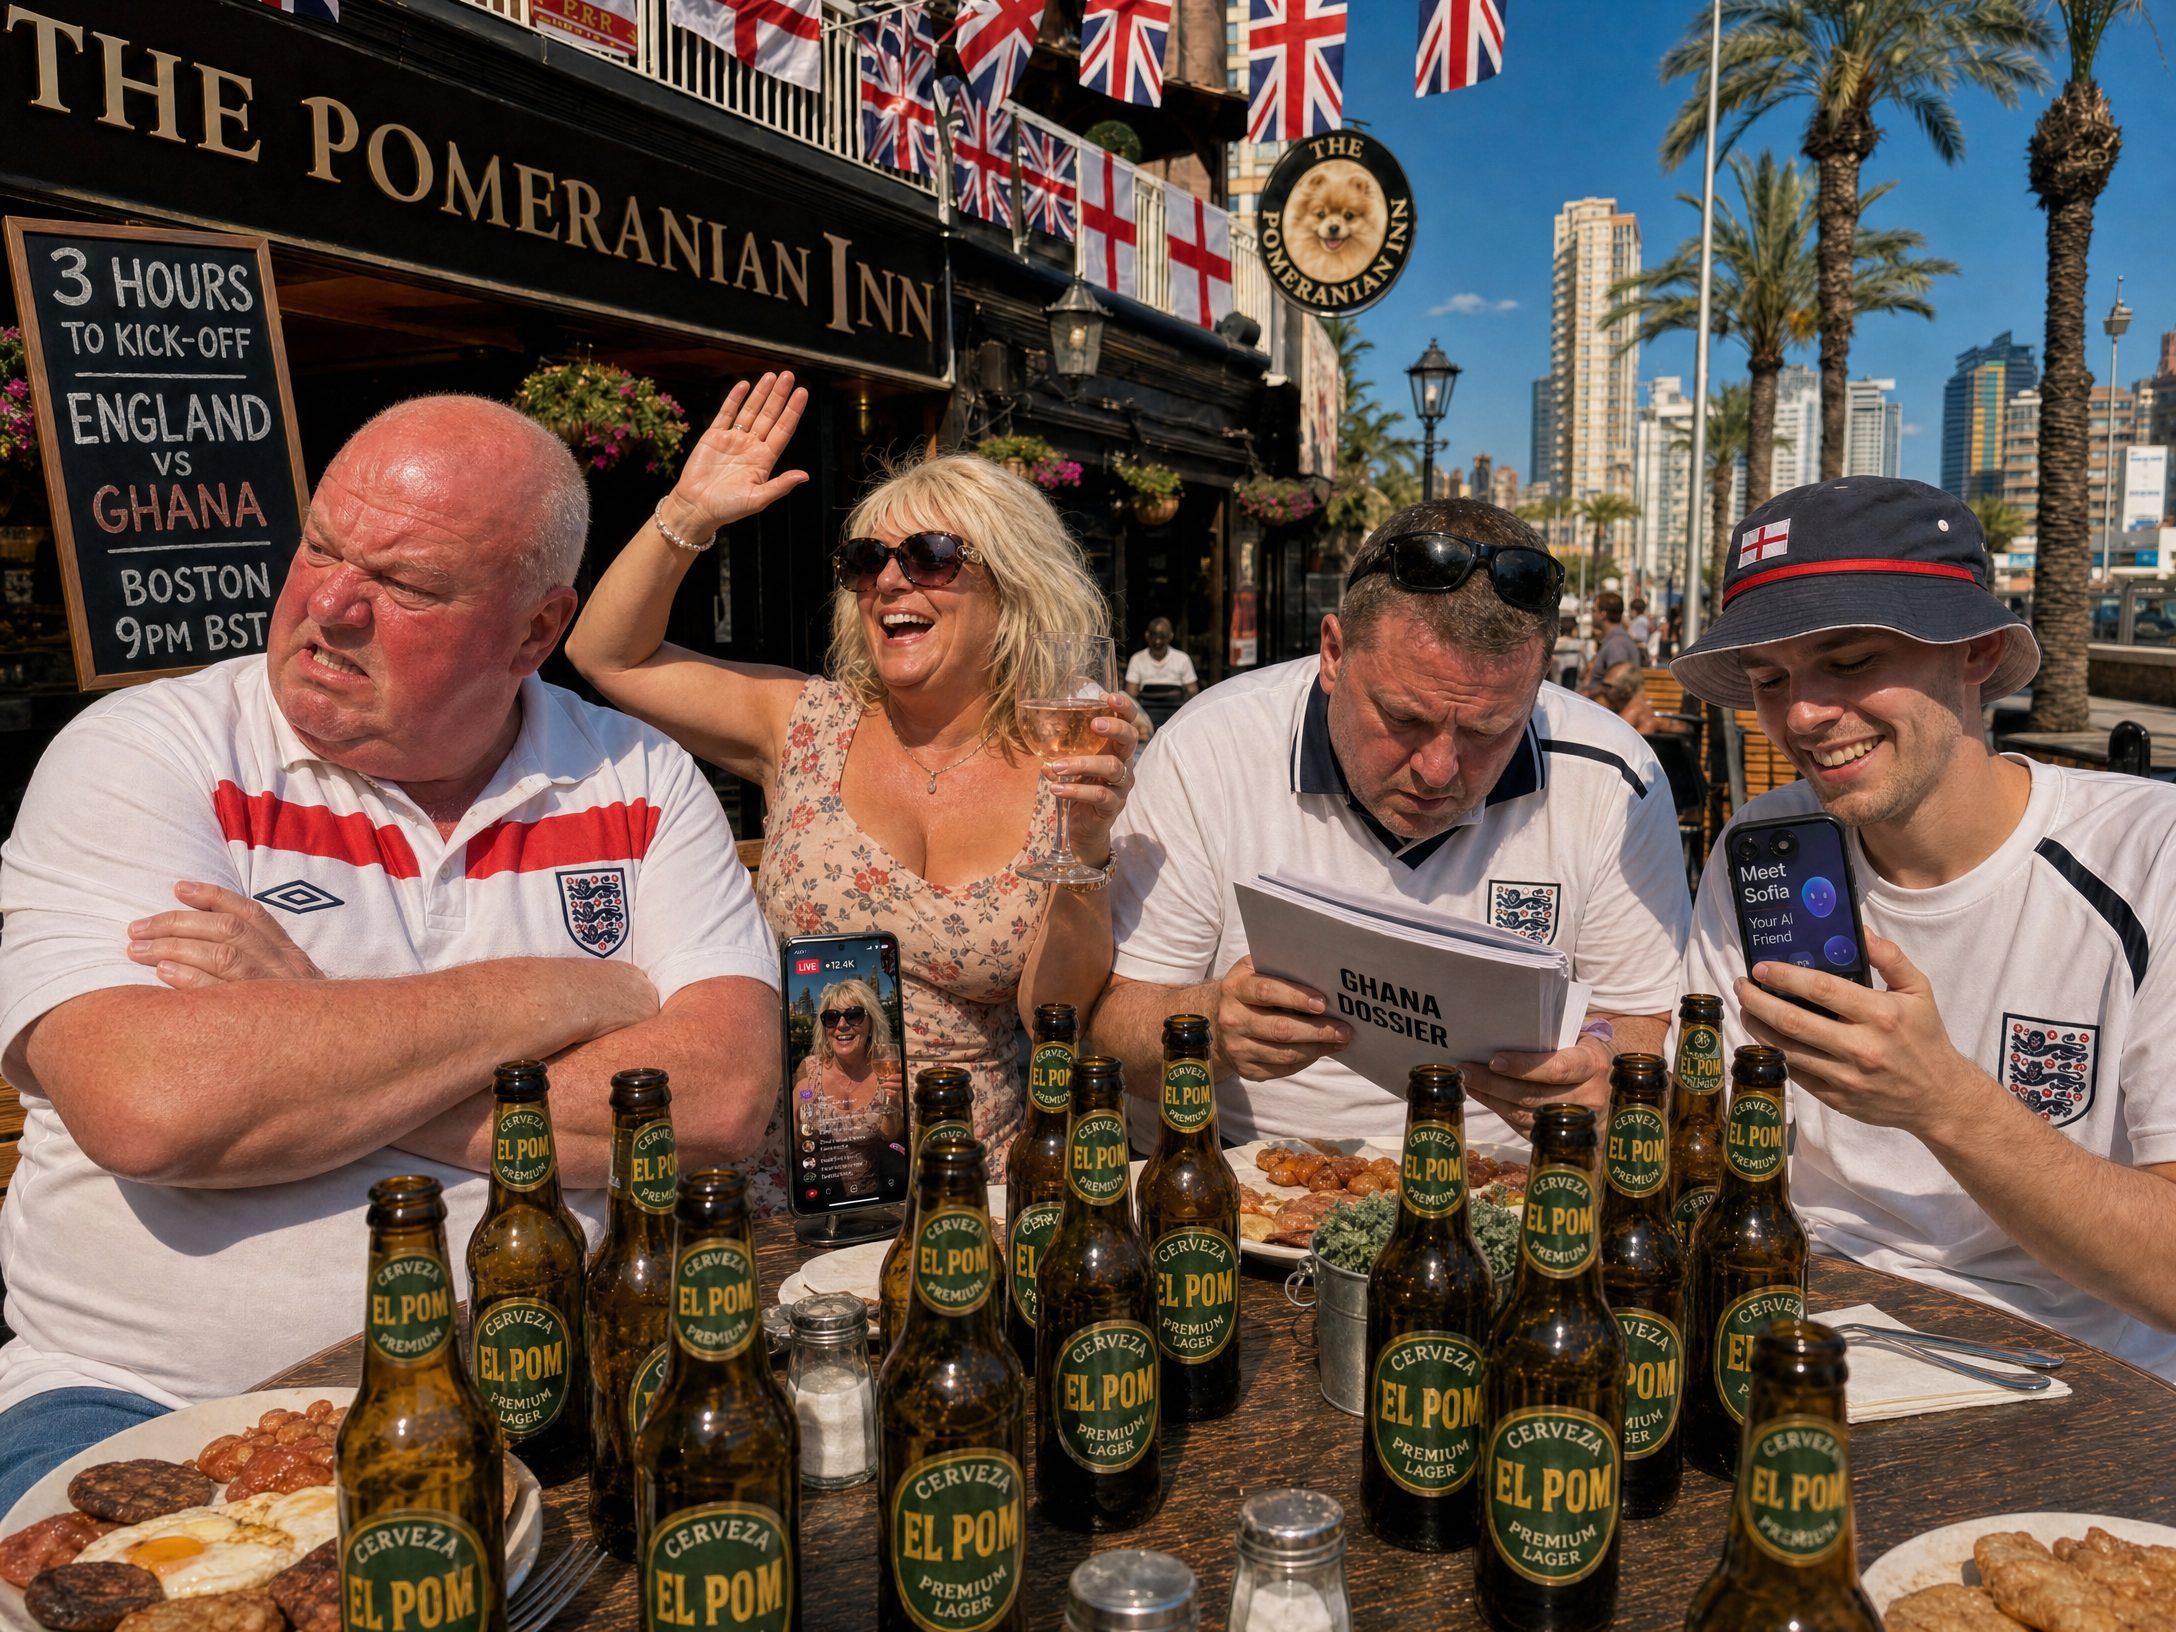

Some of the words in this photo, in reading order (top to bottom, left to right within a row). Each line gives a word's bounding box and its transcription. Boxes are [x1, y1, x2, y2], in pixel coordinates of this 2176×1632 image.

[1308, 137, 1364, 160] THE
[3, 4, 261, 162] THE
[302, 97, 810, 306] POMERANIAN
[823, 232, 934, 342] INN
[1262, 210, 1394, 306] POMERANIAN
[1384, 198, 1408, 255] INN
[50, 247, 92, 305] 3
[112, 256, 253, 313] HOURS
[62, 321, 104, 355] TO
[115, 323, 250, 359] KICK-OFF
[67, 392, 272, 444] ENGLAND
[151, 451, 192, 477] VS
[93, 481, 268, 534] GHANA
[120, 562, 271, 606] BOSTON
[115, 617, 192, 659] 9PM
[205, 612, 267, 651] BST
[1740, 863, 1787, 882] Meet
[1744, 884, 1790, 903] Sofia
[1749, 917, 1777, 929] Your
[1781, 913, 1794, 926] AI
[1752, 931, 1793, 946] Friend
[798, 962, 817, 972] LIVE
[831, 960, 855, 969] 12.4K
[1339, 967, 1442, 1020] GHANA
[1337, 992, 1449, 1049] DOSSIER
[1033, 1067, 1046, 1086] EL
[1168, 1066, 1207, 1082] CERVEZA
[1680, 1056, 1694, 1075] EL
[1697, 1059, 1721, 1076] POM
[1165, 1084, 1180, 1105] EL
[1182, 1083, 1211, 1105] POM
[1168, 1107, 1208, 1124] PREMIUM
[1734, 1101, 1778, 1119] CERVEZA
[500, 1115, 544, 1132] CERVEZA
[1079, 1120, 1121, 1139] CERVEZA
[1615, 1114, 1660, 1133] CERVEZA
[1728, 1121, 1745, 1146] EL
[1749, 1125, 1782, 1148] POM
[497, 1138, 514, 1160] EL
[517, 1134, 550, 1160] POM
[638, 1128, 674, 1150] CERVE
[1409, 1132, 1457, 1151] CERVEZA
[1608, 1135, 1627, 1161] EL
[1632, 1139, 1665, 1163] POM
[1073, 1145, 1093, 1170] EL
[1096, 1142, 1126, 1170] POM
[1404, 1153, 1422, 1182] EL
[1425, 1155, 1461, 1183] POM
[1732, 1151, 1777, 1169] PREMIUM
[502, 1162, 546, 1180] PREMIUM
[632, 1158, 655, 1182] EL
[1079, 1174, 1123, 1192] PREMIUM
[1612, 1166, 1659, 1185] PREMIUM
[1407, 1185, 1456, 1204] PREMIUM
[1532, 1175, 1589, 1201] CERVEZA
[1683, 1195, 1713, 1213] CERV
[926, 1218, 982, 1241] CERVEZA
[1022, 1212, 1060, 1235] CERV
[1526, 1202, 1548, 1237] EL
[1551, 1204, 1594, 1238] POM
[920, 1246, 943, 1276] EL
[947, 1244, 989, 1277] POM
[1160, 1238, 1226, 1263] CERVEZA
[1530, 1239, 1588, 1263] PREMIUM
[377, 1261, 439, 1287] CERVEZA
[684, 1251, 745, 1278] CERVEZA
[679, 1285, 704, 1317] EL
[708, 1278, 754, 1317] POM
[1185, 1268, 1233, 1308] POM
[372, 1295, 396, 1325] EL
[401, 1287, 449, 1325] POM
[485, 1310, 553, 1336] CERVEZA
[685, 1319, 748, 1346] PREMIUM
[1162, 1314, 1224, 1336] PREMIUM
[379, 1327, 442, 1354] PREMIUM
[1072, 1334, 1147, 1363] CERVEZA
[1173, 1335, 1215, 1349] LAGER
[1622, 1321, 1670, 1352] VEZA
[480, 1345, 504, 1381] EL
[509, 1340, 563, 1382] POM
[1391, 1345, 1477, 1376] CERVEZA
[490, 1387, 552, 1410] PREMIUM
[1063, 1372, 1095, 1413] EL
[1102, 1363, 1154, 1412] POM
[500, 1410, 543, 1424] LAGER
[1381, 1378, 1413, 1427] EL
[1422, 1383, 1480, 1430] POM
[1076, 1414, 1146, 1442] PREMIUM
[1625, 1408, 1664, 1429] MIUM
[1087, 1439, 1135, 1458] LAGER
[1392, 1435, 1470, 1462] PREMIUM
[1506, 1421, 1604, 1458] CERVEZA
[1624, 1431, 1651, 1443] GER
[1762, 1431, 1840, 1458] CERVEZA
[915, 1464, 1011, 1500] CERVEZA
[1404, 1460, 1457, 1480] LAGER
[1495, 1456, 1533, 1511] EL
[1542, 1462, 1614, 1515] POM
[1750, 1465, 1785, 1511] EL
[1791, 1470, 1847, 1512] POM
[664, 1520, 770, 1559] CERVEZA
[903, 1509, 943, 1562] EL
[951, 1500, 1020, 1561] POM
[1508, 1520, 1598, 1549] PREMIUM
[1758, 1515, 1838, 1547] PREMIUM
[354, 1526, 458, 1564] CERVEZA
[1522, 1545, 1583, 1567] LAGER
[656, 1569, 696, 1627] EL
[704, 1557, 783, 1627] POM
[918, 1565, 1008, 1601] PREMIUM
[348, 1575, 384, 1632] EL
[390, 1563, 476, 1632] POM
[932, 1595, 994, 1619] LAGER
